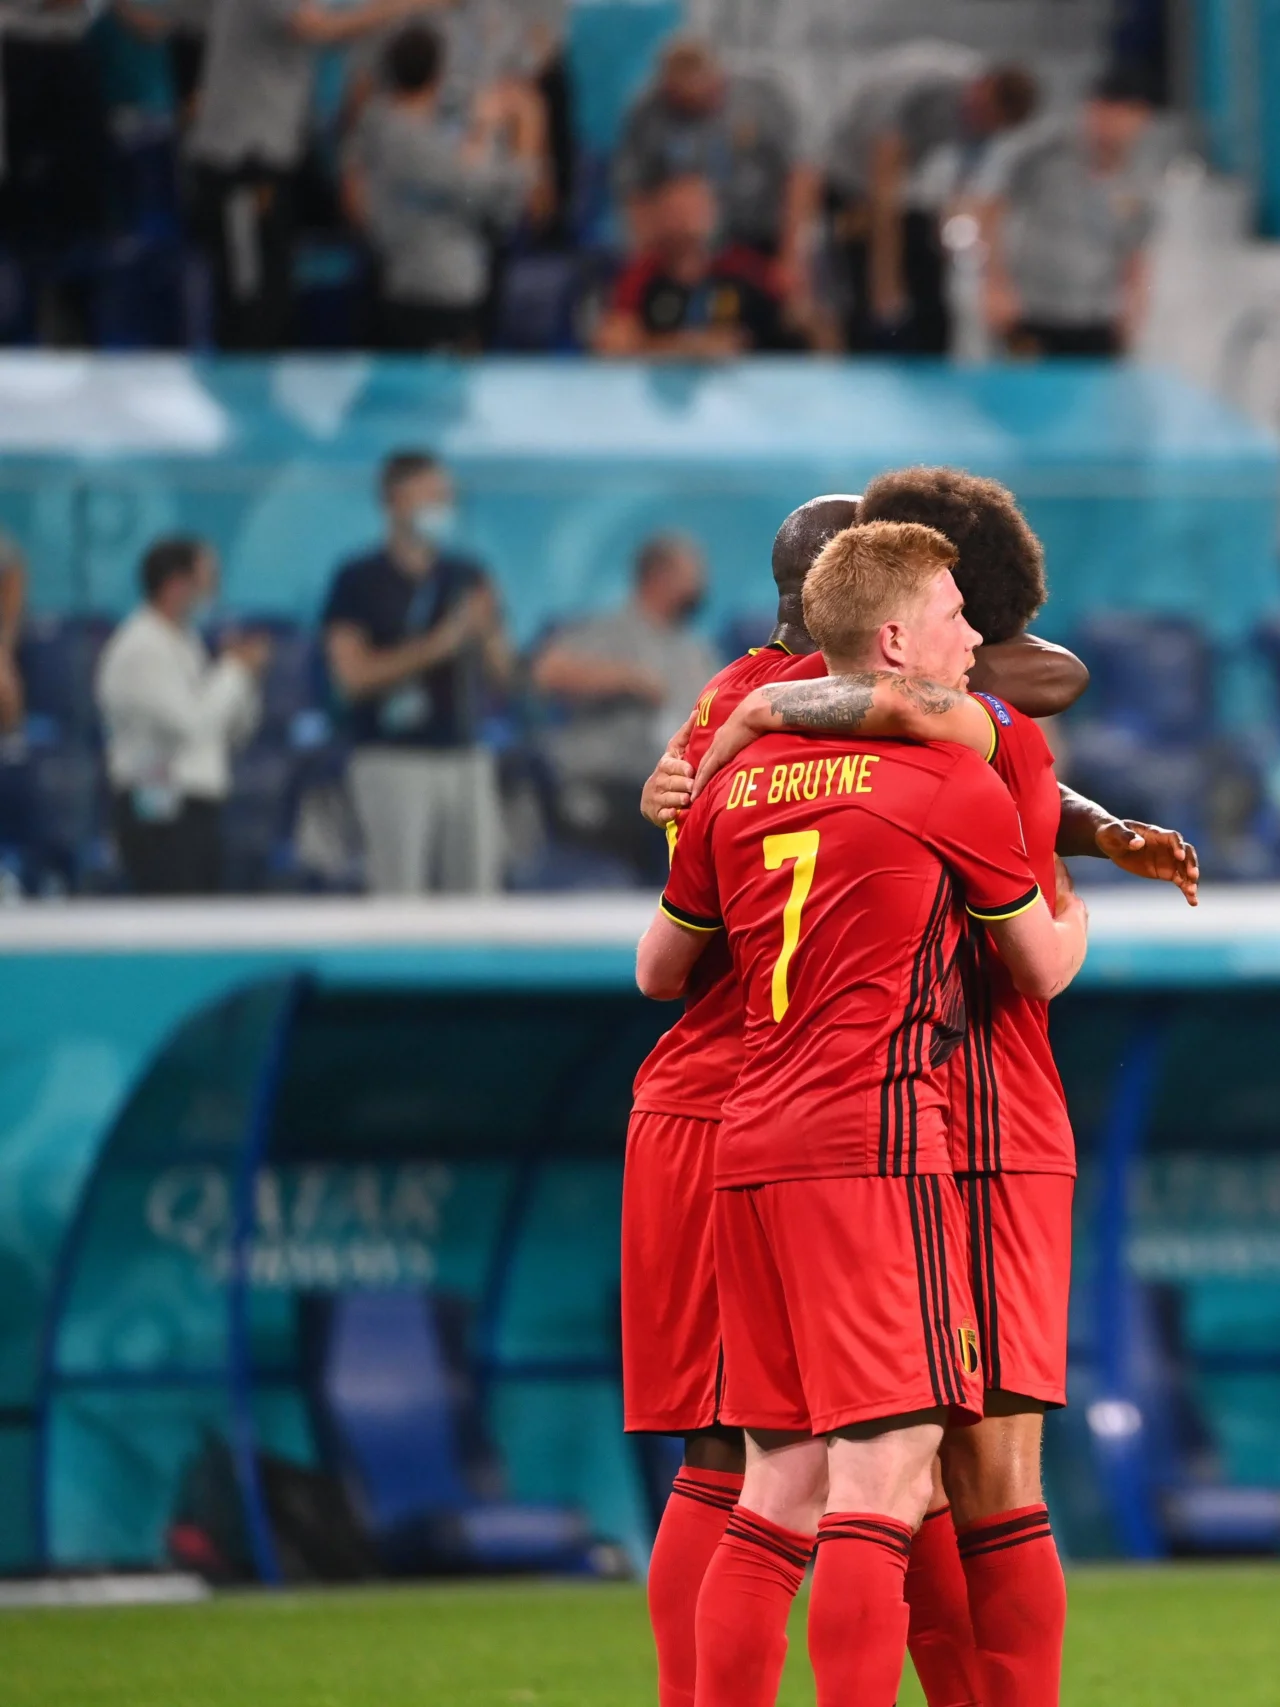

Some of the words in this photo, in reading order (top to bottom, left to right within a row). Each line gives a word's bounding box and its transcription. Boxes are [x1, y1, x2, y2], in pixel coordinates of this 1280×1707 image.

[727, 767, 764, 810] DE
[767, 754, 881, 804] BRUYNE
[762, 829, 820, 1024] 7
